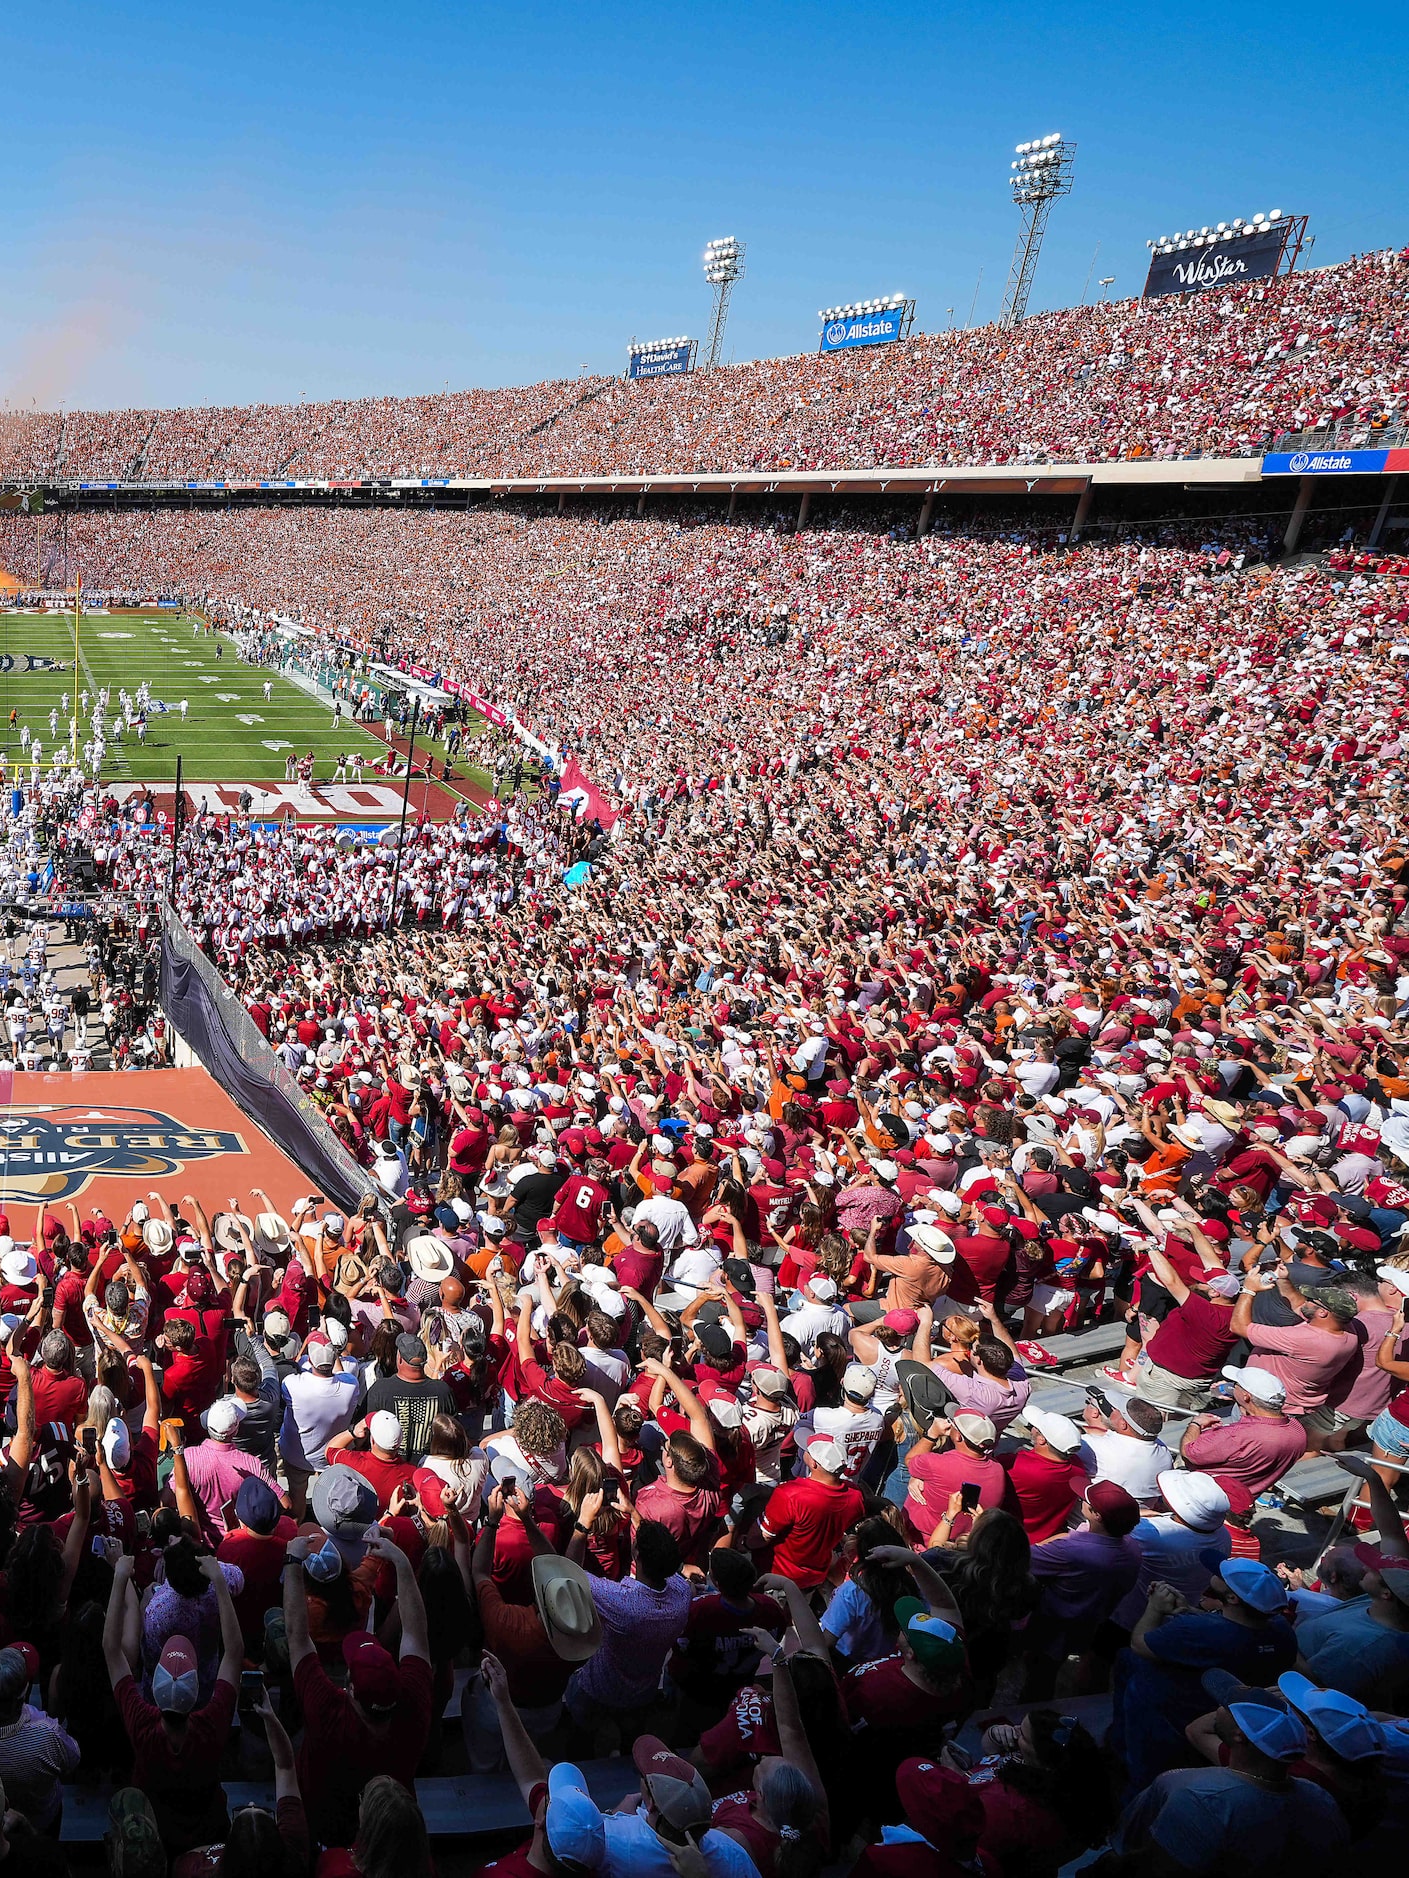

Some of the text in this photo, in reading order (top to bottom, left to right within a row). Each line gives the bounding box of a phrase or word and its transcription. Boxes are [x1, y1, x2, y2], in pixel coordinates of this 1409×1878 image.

[1173, 245, 1249, 286] WinStar
[845, 319, 896, 341] Allstate
[1307, 456, 1351, 470] Allstate
[35, 928, 45, 938] 16
[45, 987, 52, 997] 6
[51, 1008, 65, 1019] 98
[64, 1134, 226, 1150] RED
[575, 1185, 594, 1209] 6
[769, 1197, 793, 1206] MAYFIELD
[844, 1430, 880, 1444] SHEPARD
